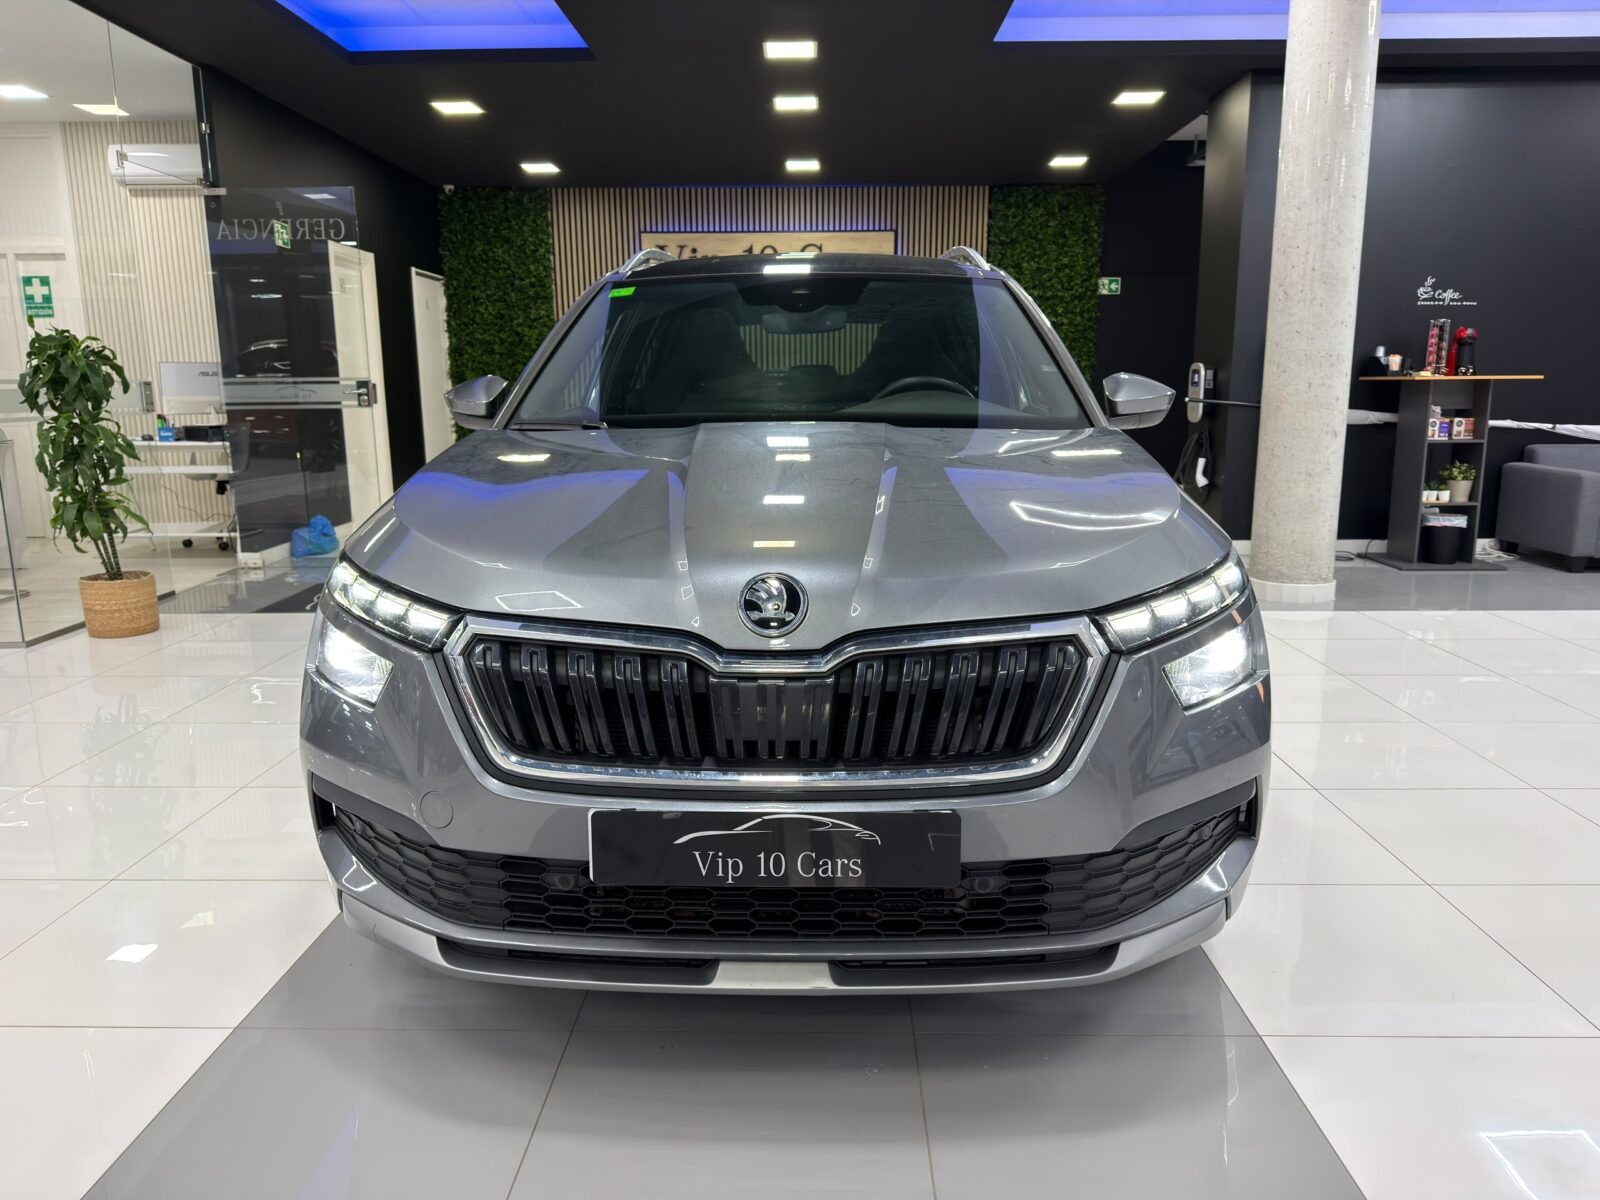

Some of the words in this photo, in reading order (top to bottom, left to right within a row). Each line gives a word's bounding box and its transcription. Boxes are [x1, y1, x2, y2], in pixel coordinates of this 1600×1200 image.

[1435, 289, 1463, 306] Coffee
[692, 851, 744, 884] Vip
[756, 851, 786, 878] 10
[797, 851, 862, 878] Cars
